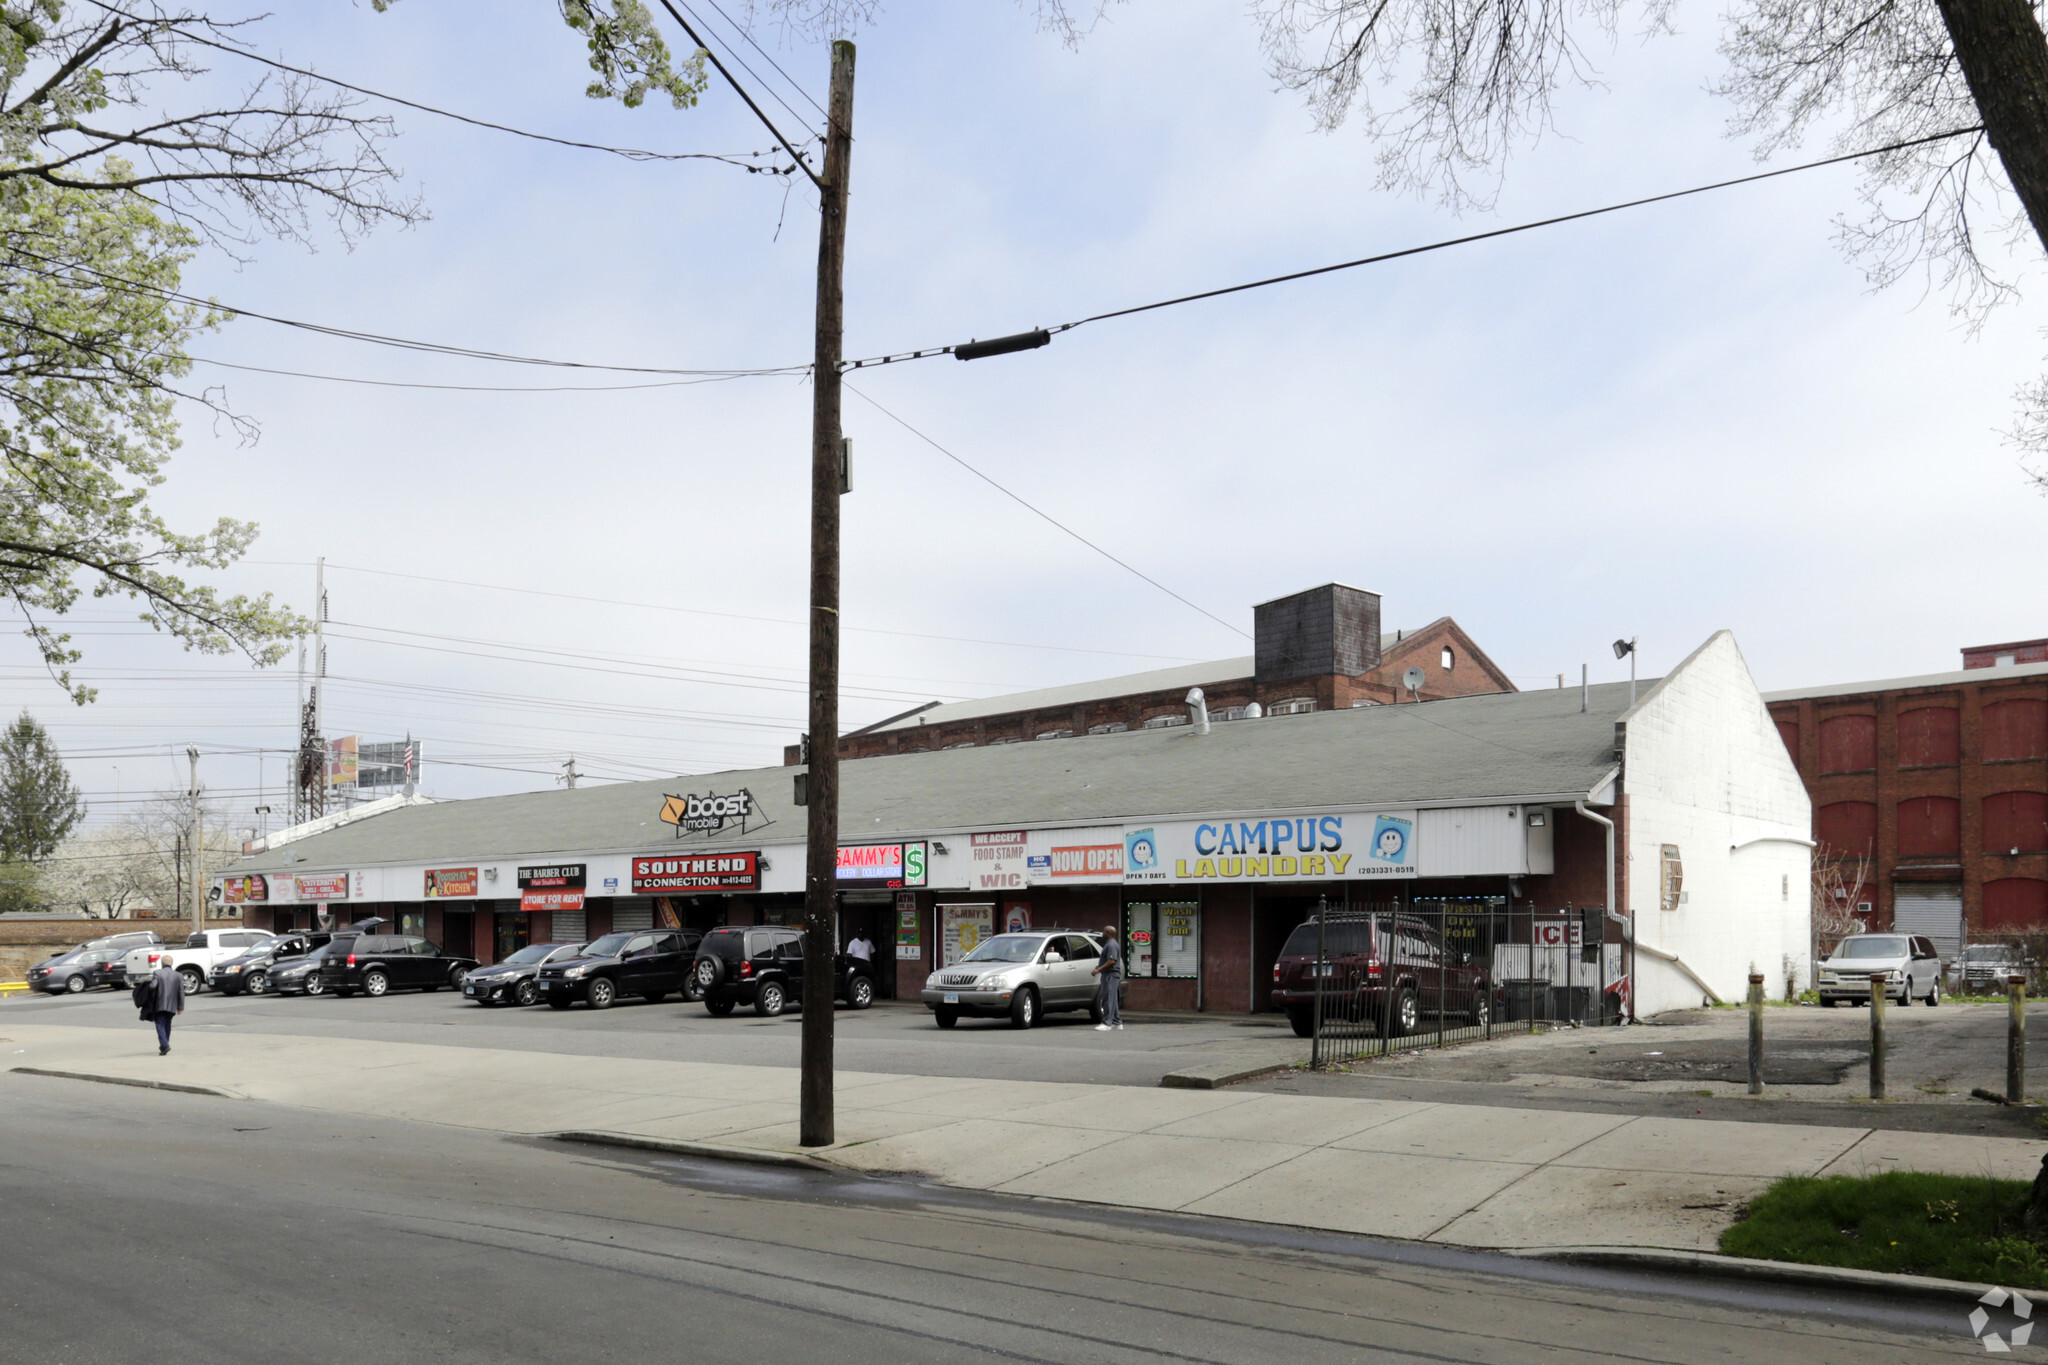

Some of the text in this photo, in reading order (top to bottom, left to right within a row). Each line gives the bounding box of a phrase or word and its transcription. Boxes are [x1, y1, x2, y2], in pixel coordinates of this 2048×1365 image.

[687, 791, 749, 818] boost
[687, 817, 719, 829] mobile
[975, 832, 1022, 844] WE ACCEPT
[1194, 816, 1343, 855] CAMPUS
[837, 845, 901, 868] SAMMY'S
[973, 846, 1024, 861] FOOD STAMP
[1052, 848, 1123, 872] NOW OPEN
[1175, 853, 1353, 879] LAUNDRY
[519, 866, 580, 879] THE BARBER CLUB
[638, 858, 747, 875] SOUTHEND
[994, 862, 1003, 871] &
[1358, 866, 1415, 875] (203)331-0519
[302, 879, 337, 887] UNIVERSITY
[541, 878, 556, 886] Studio
[643, 876, 720, 888] CONNECTION
[980, 872, 1022, 888] WIC
[443, 881, 471, 895] KITCHEN
[524, 893, 584, 905] STORE FOR RENT
[897, 892, 915, 903] ATM
[949, 909, 989, 919] SAMMY'S
[1163, 907, 1192, 916] Wash
[1169, 918, 1187, 926] Dry
[1448, 916, 1475, 926] Dry
[1131, 931, 1151, 942] OPEN
[1167, 927, 1189, 935] Fold
[1445, 928, 1476, 938] Fold
[1534, 924, 1580, 945] ICE
